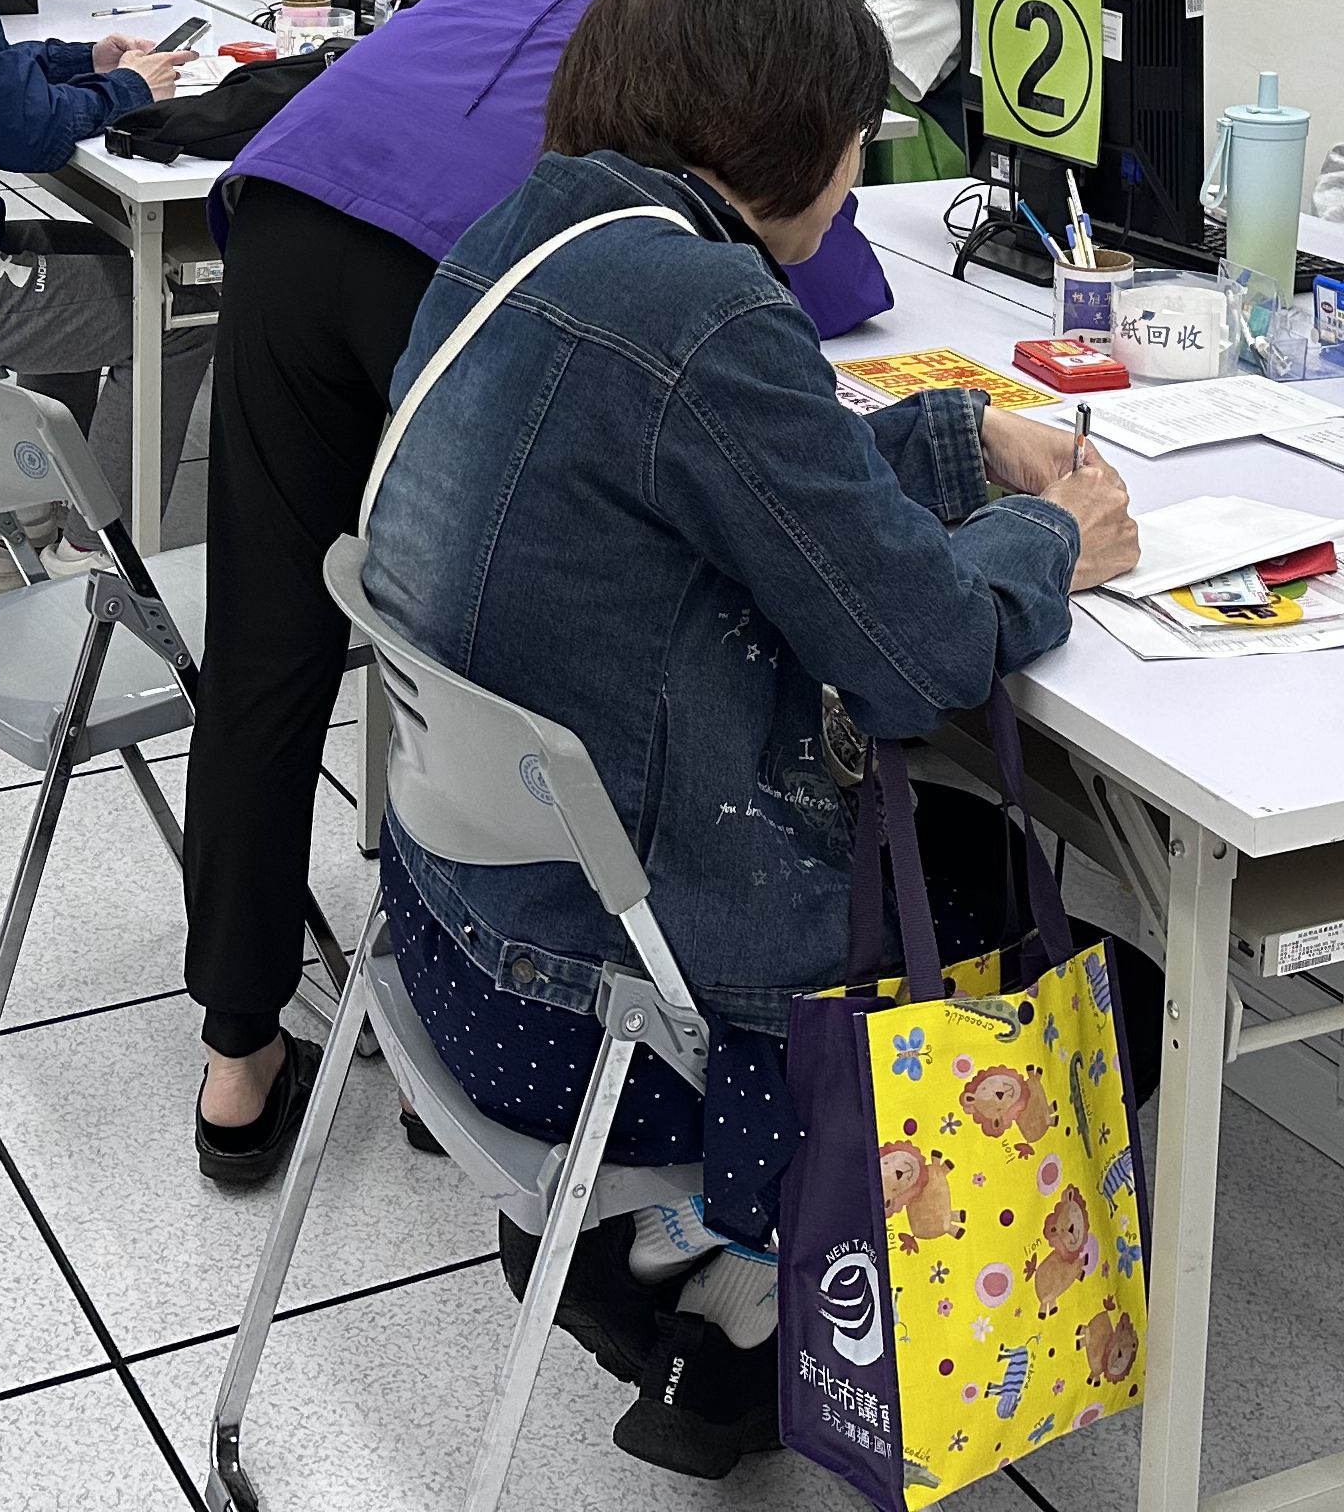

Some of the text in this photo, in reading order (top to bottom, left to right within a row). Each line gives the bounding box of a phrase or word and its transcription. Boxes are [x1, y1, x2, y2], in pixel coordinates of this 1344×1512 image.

[1015, 0, 1067, 118] 2
[943, 1008, 995, 1032] crocodile
[1001, 1139, 1016, 1165] lion
[825, 1240, 850, 1265] NEW
[1023, 1238, 1042, 1257] lion
